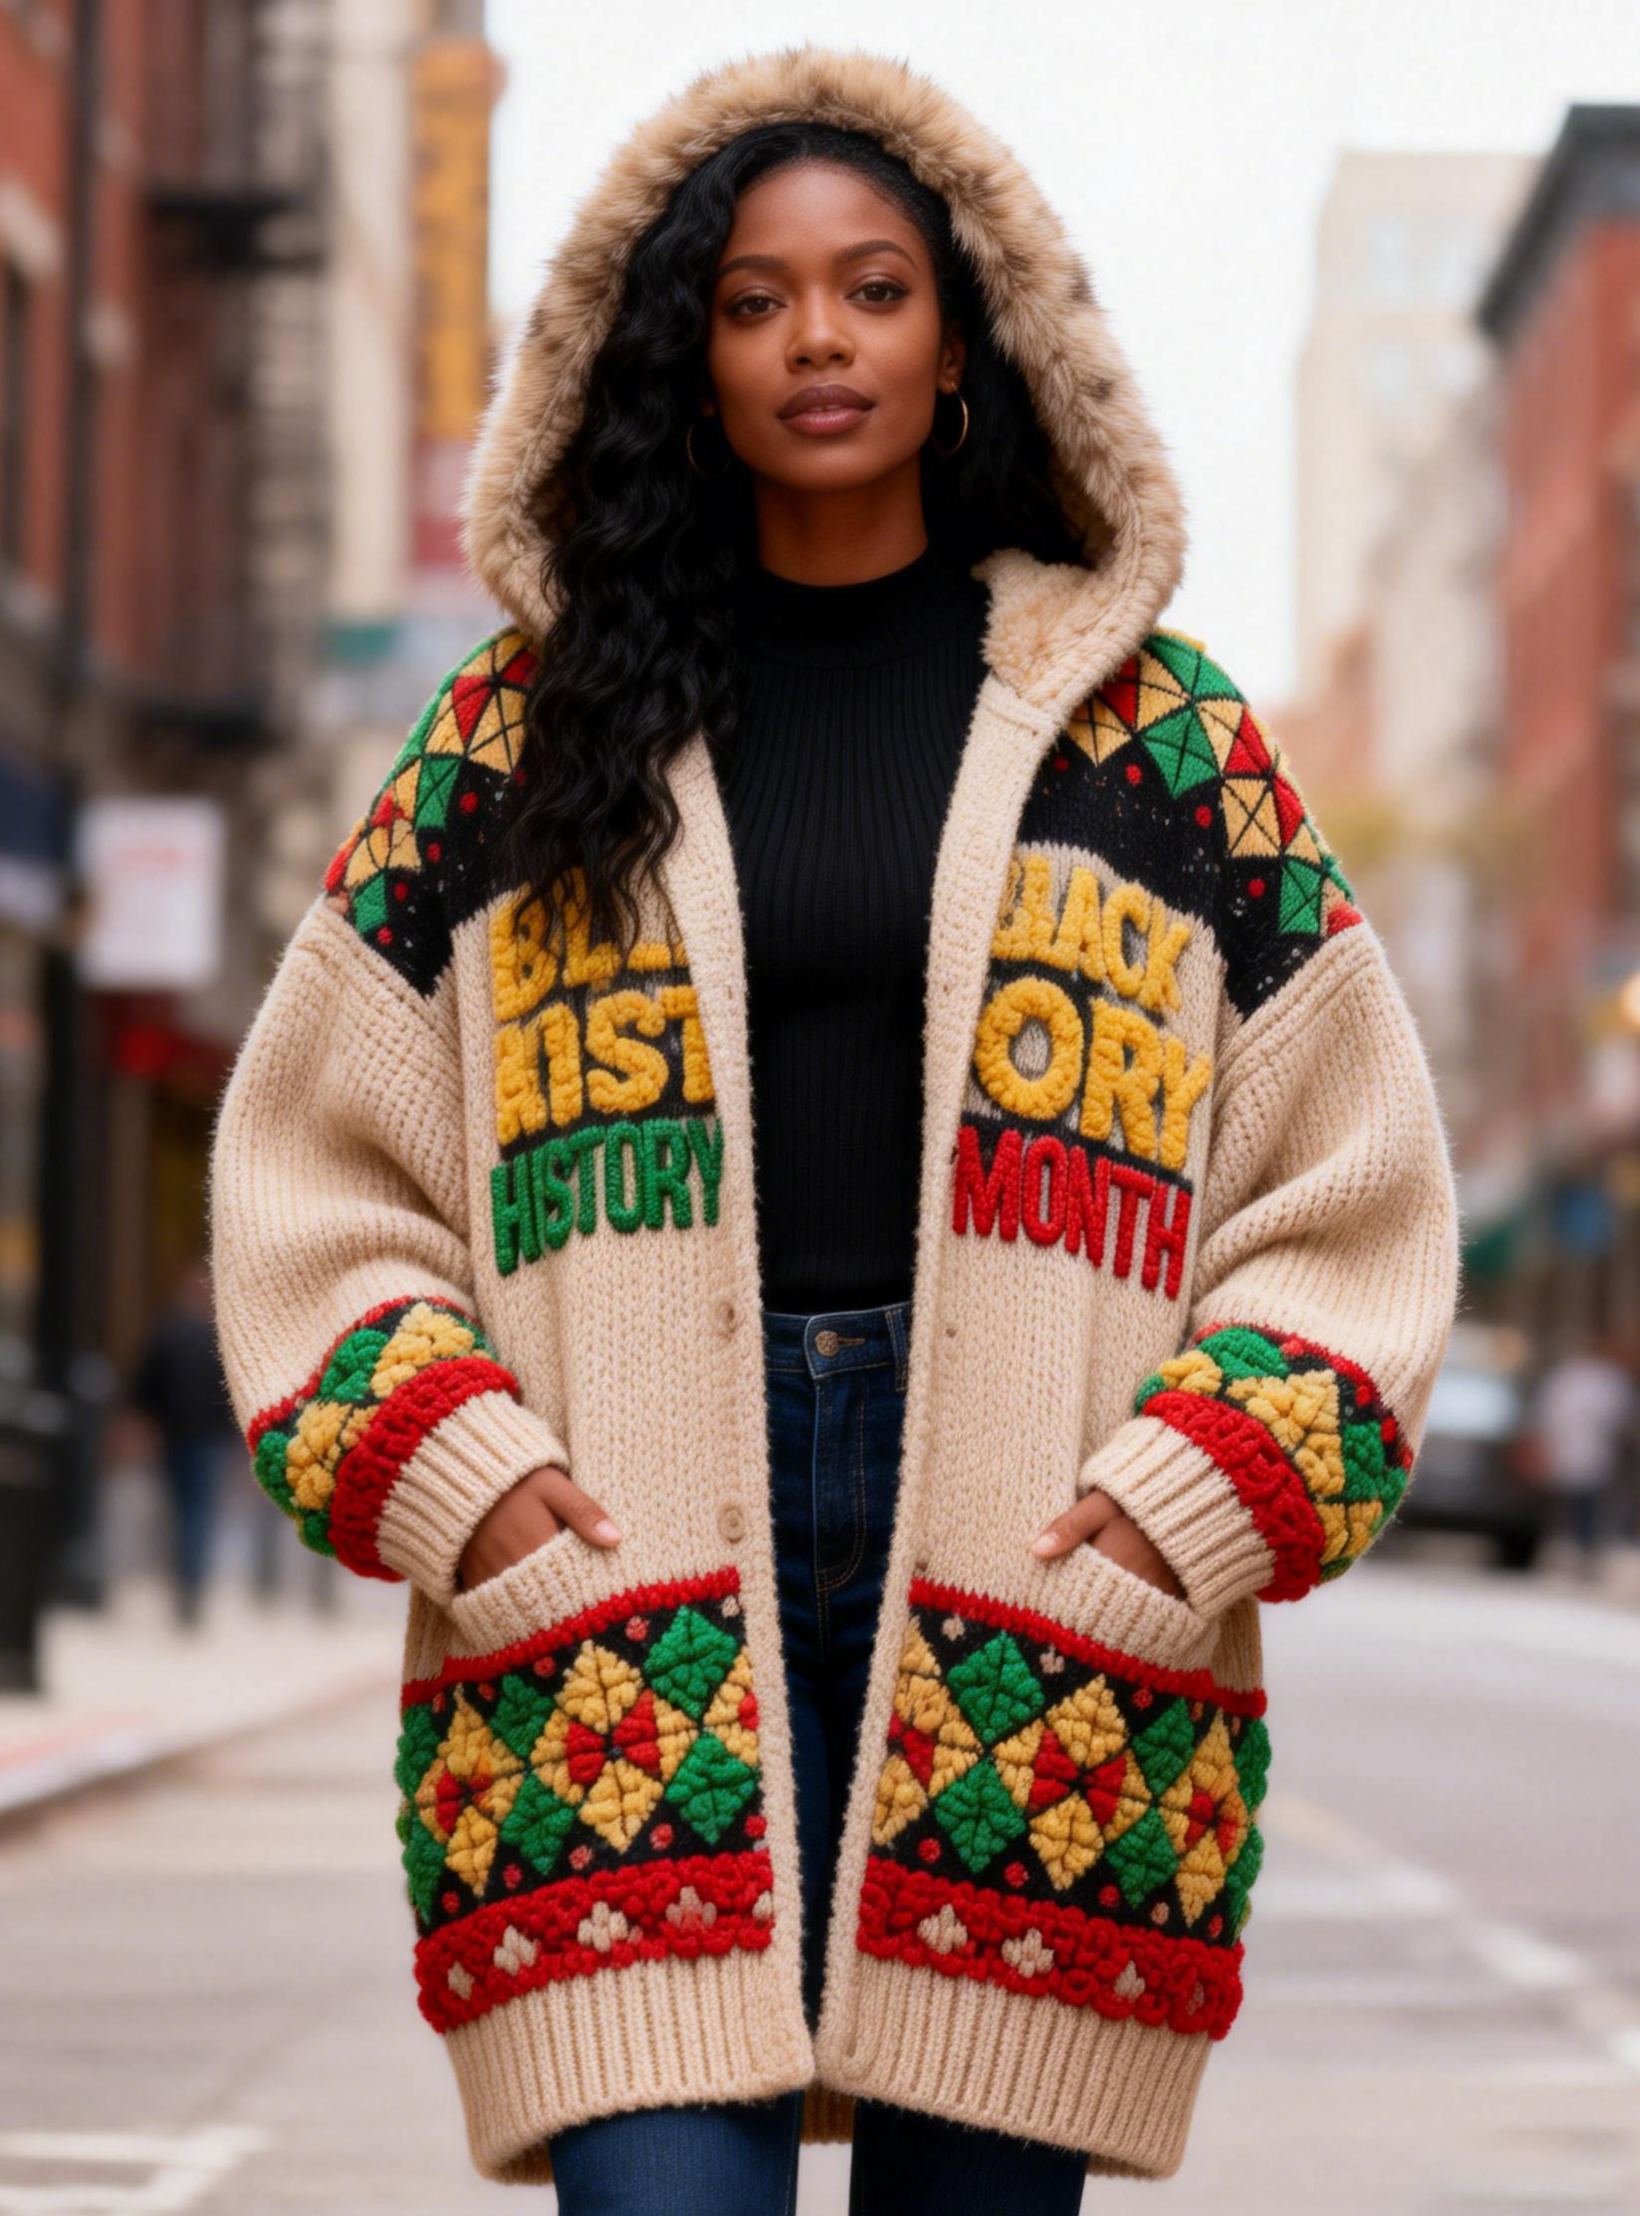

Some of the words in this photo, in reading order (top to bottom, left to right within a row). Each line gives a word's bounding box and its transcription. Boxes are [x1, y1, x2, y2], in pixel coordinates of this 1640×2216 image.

[974, 976, 1212, 1170] ORY
[490, 1117, 725, 1276] HISTORY
[952, 1125, 1192, 1299] MONTH
